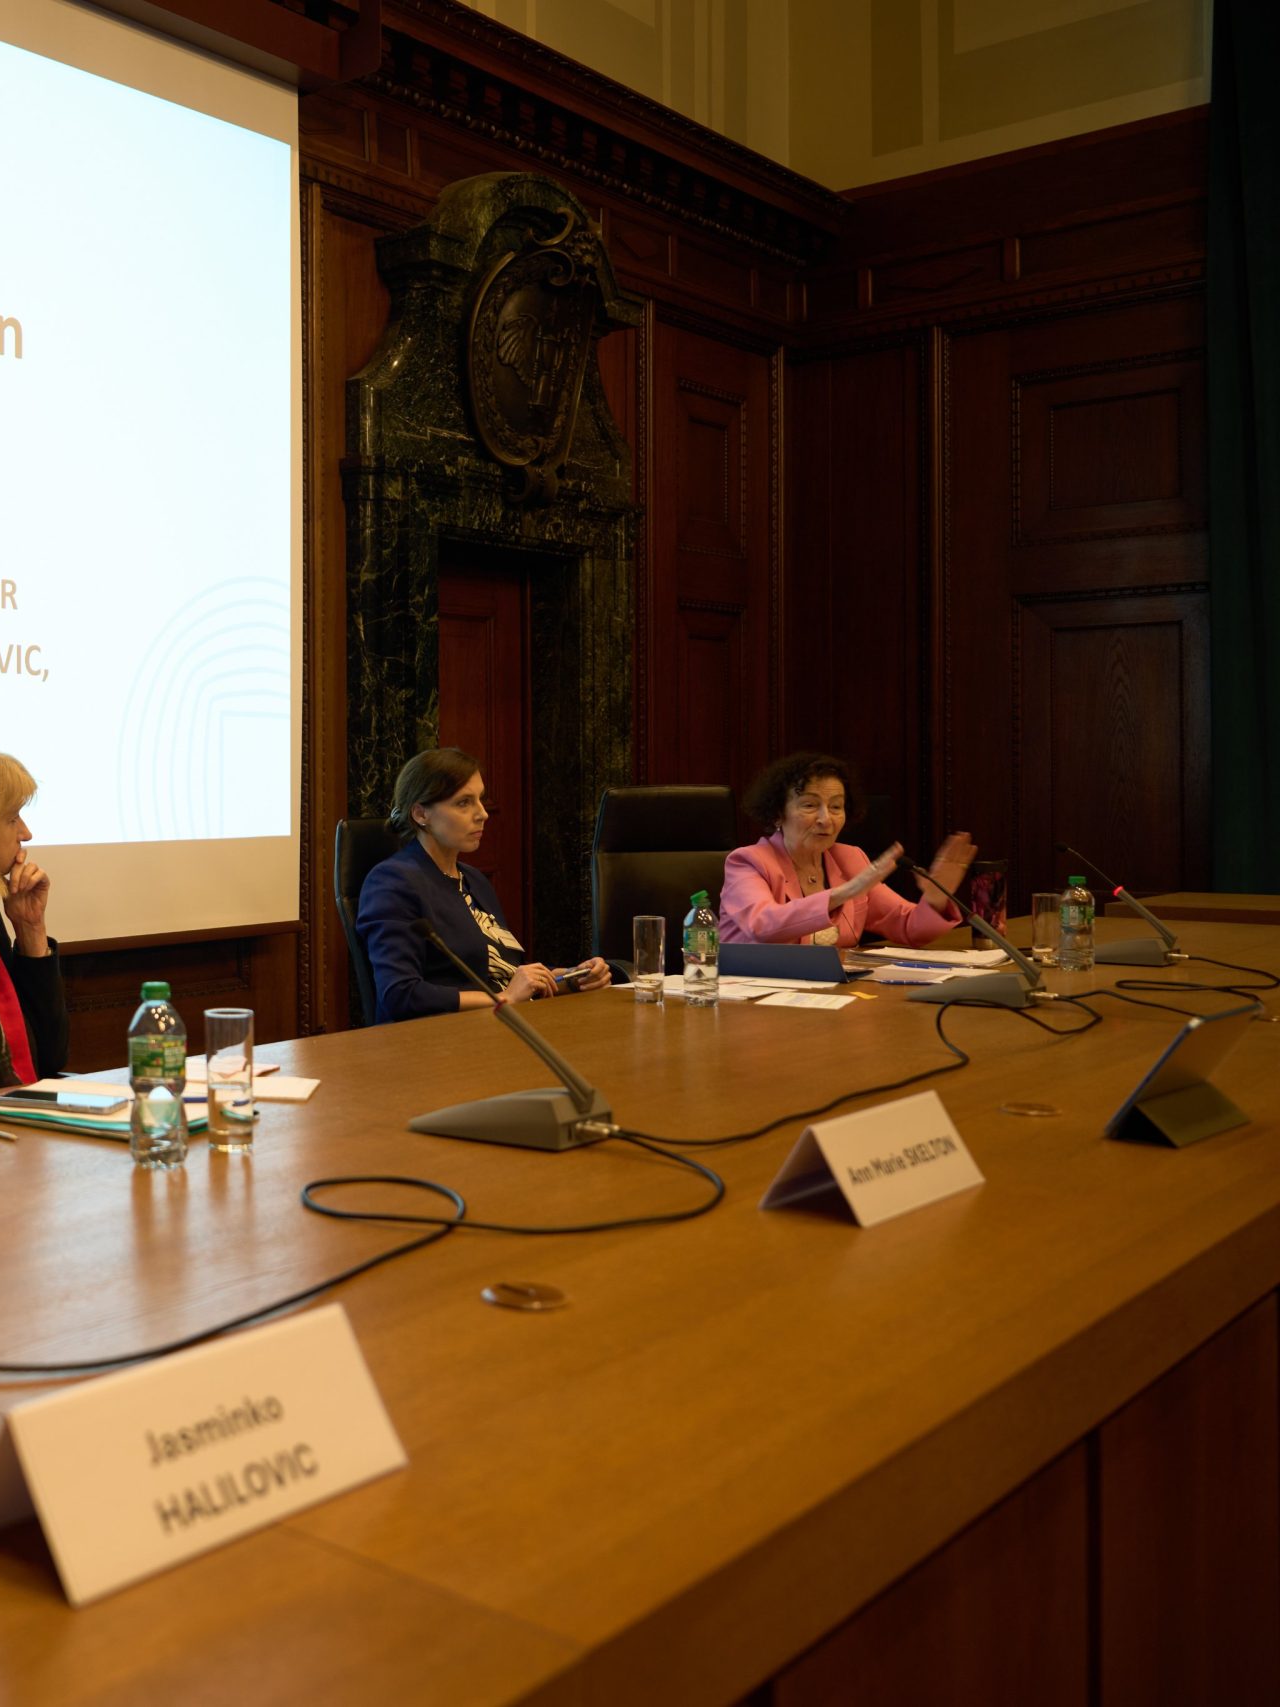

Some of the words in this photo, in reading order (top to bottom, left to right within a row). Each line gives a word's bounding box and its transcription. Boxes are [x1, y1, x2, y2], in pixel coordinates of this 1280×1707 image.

[846, 1165, 874, 1186] Ann
[869, 1152, 908, 1178] Marie
[902, 1135, 958, 1168] SKELTON
[144, 1394, 284, 1467] Jasminko
[153, 1443, 319, 1536] HALILOVIC
